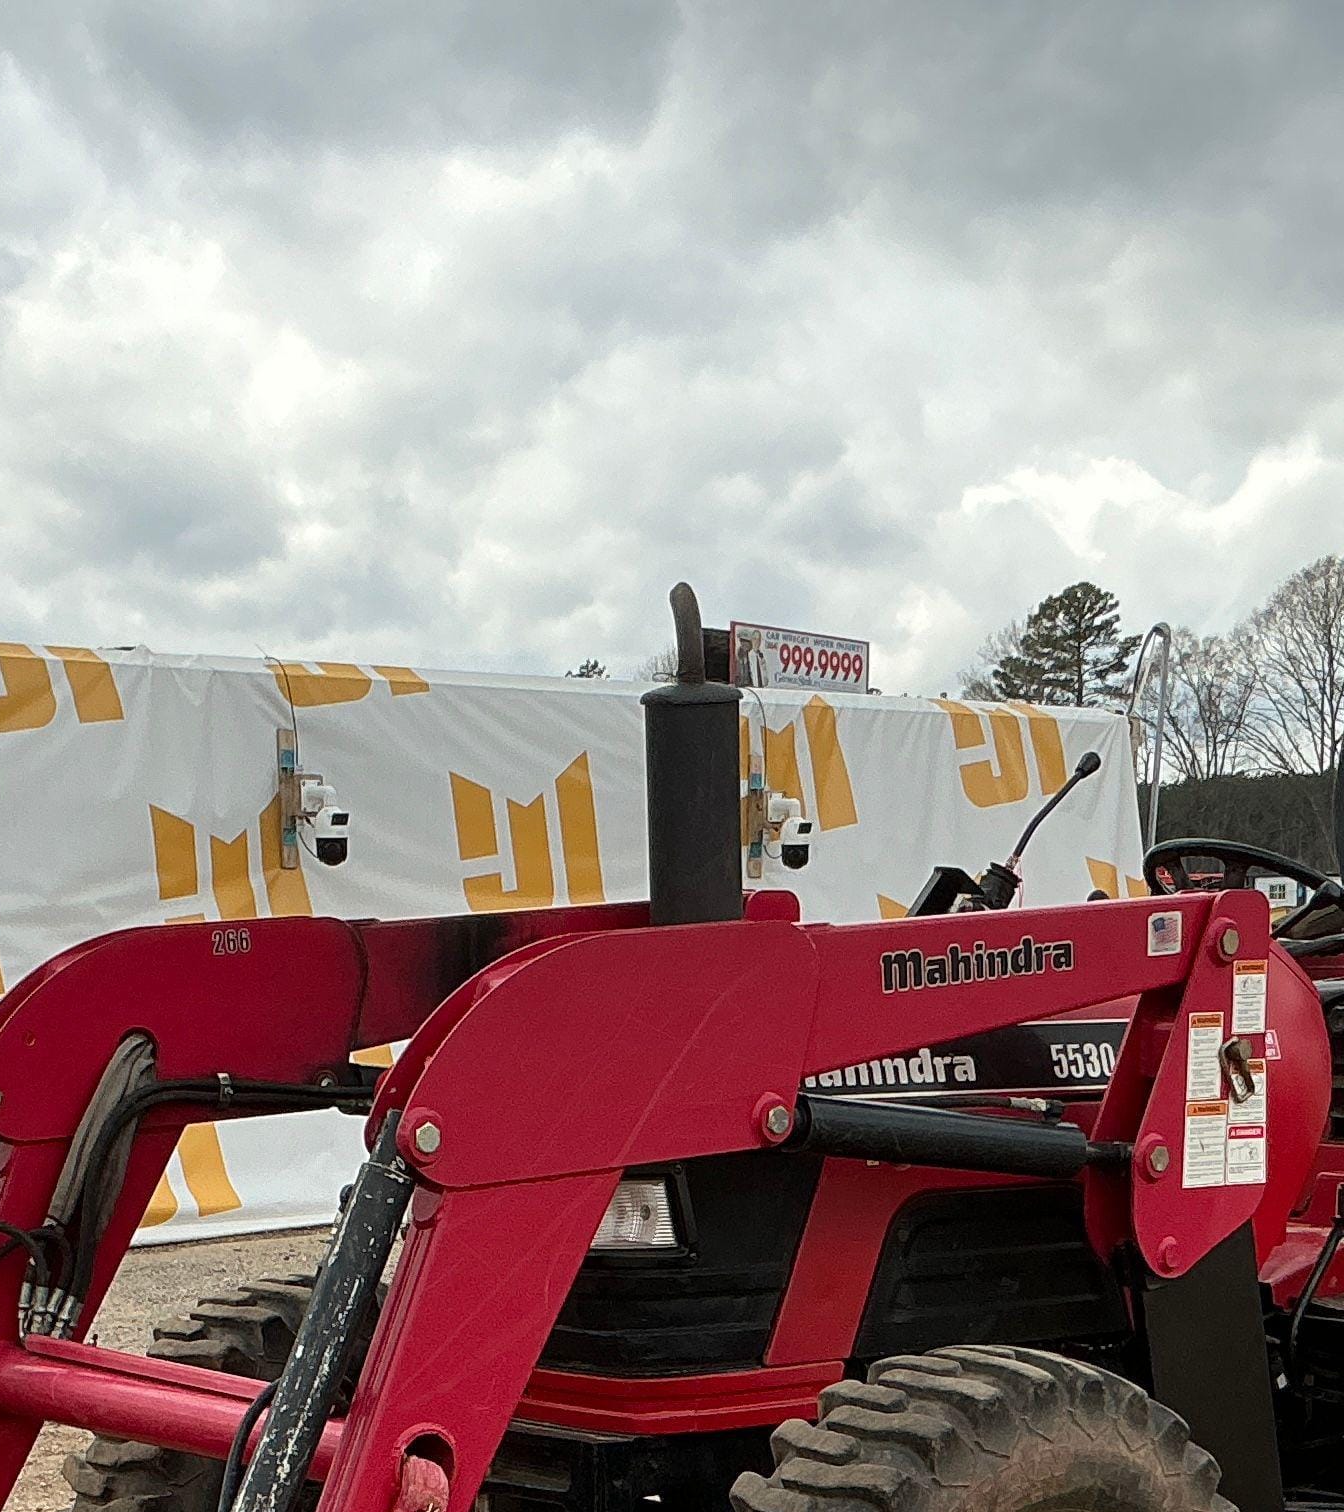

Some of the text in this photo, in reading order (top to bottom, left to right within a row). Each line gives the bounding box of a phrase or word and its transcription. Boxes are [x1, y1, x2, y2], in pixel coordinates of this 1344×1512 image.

[212, 928, 251, 955] 266
[881, 935, 1073, 994] Mahindra
[1050, 1043, 1116, 1078] 5530
